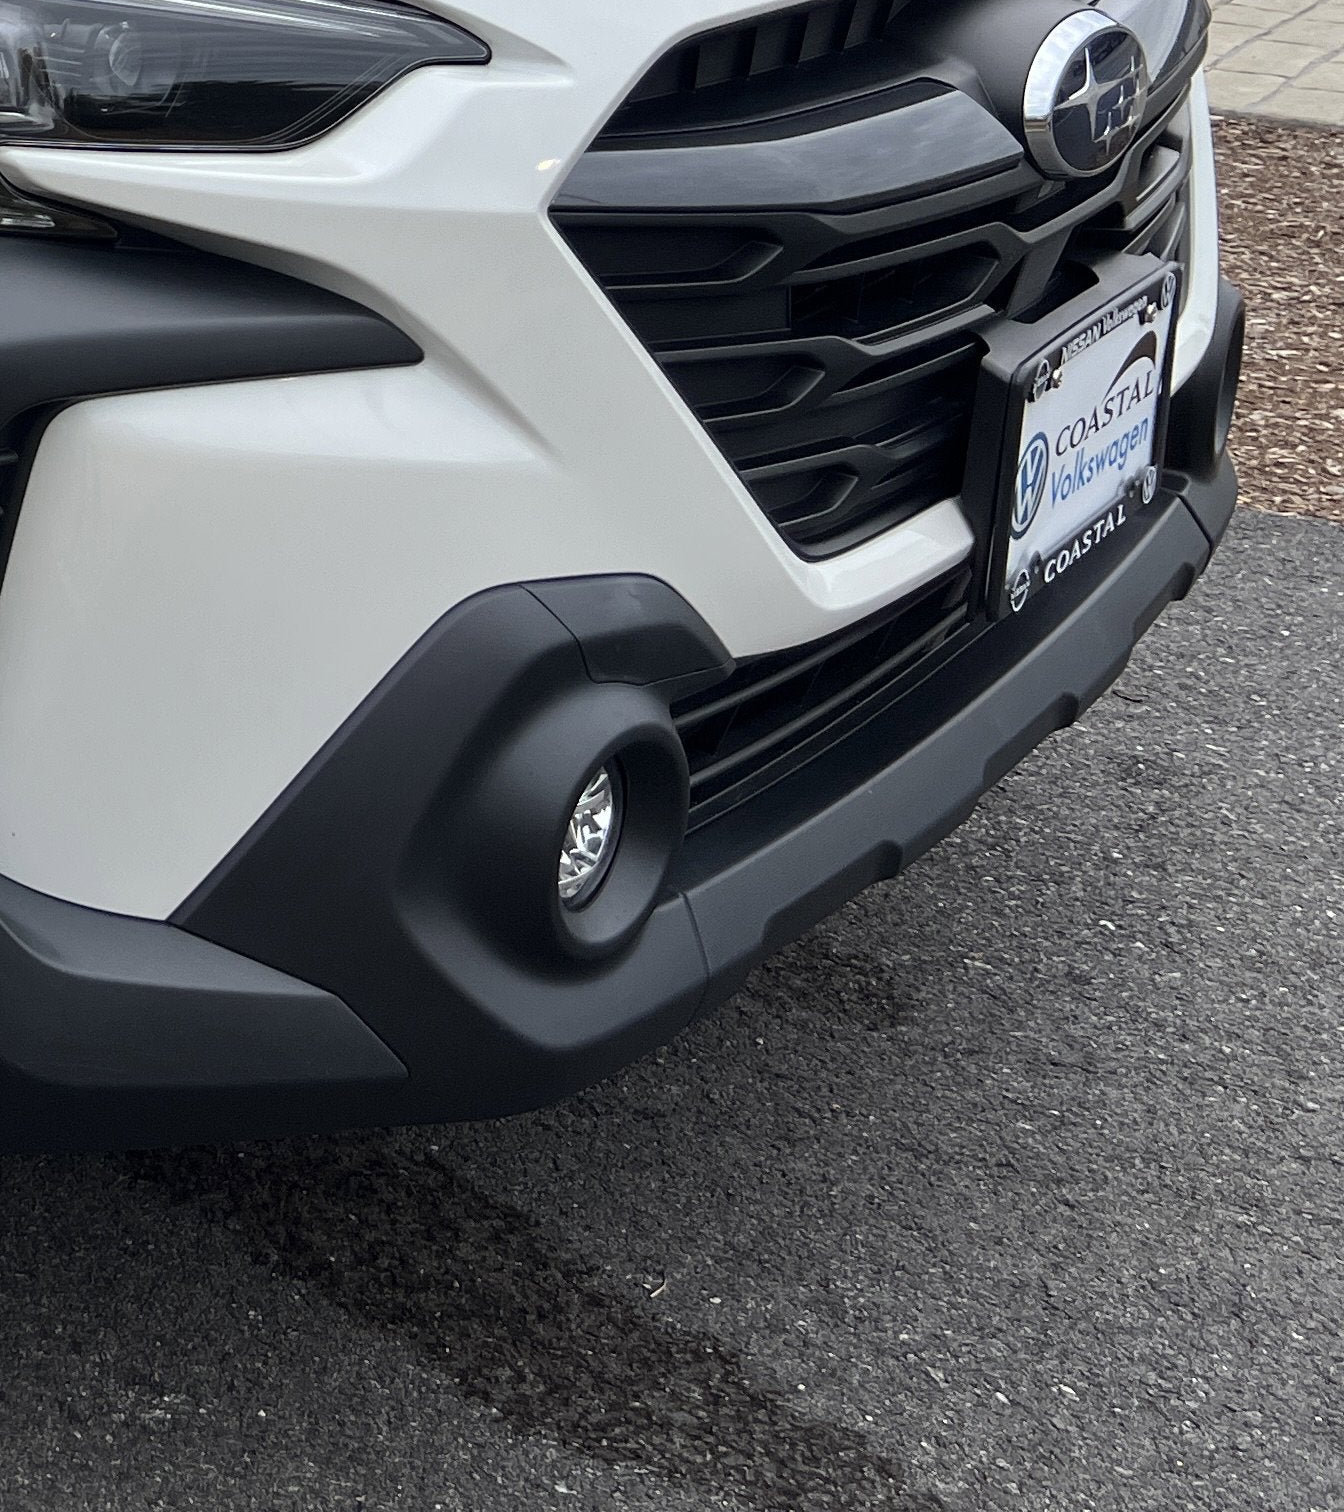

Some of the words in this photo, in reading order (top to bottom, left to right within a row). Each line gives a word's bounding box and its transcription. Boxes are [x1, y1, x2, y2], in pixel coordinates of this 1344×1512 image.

[1055, 370, 1153, 456] COASTAL
[1052, 417, 1149, 508] Volkswagen
[1044, 505, 1126, 583] COASTAL
